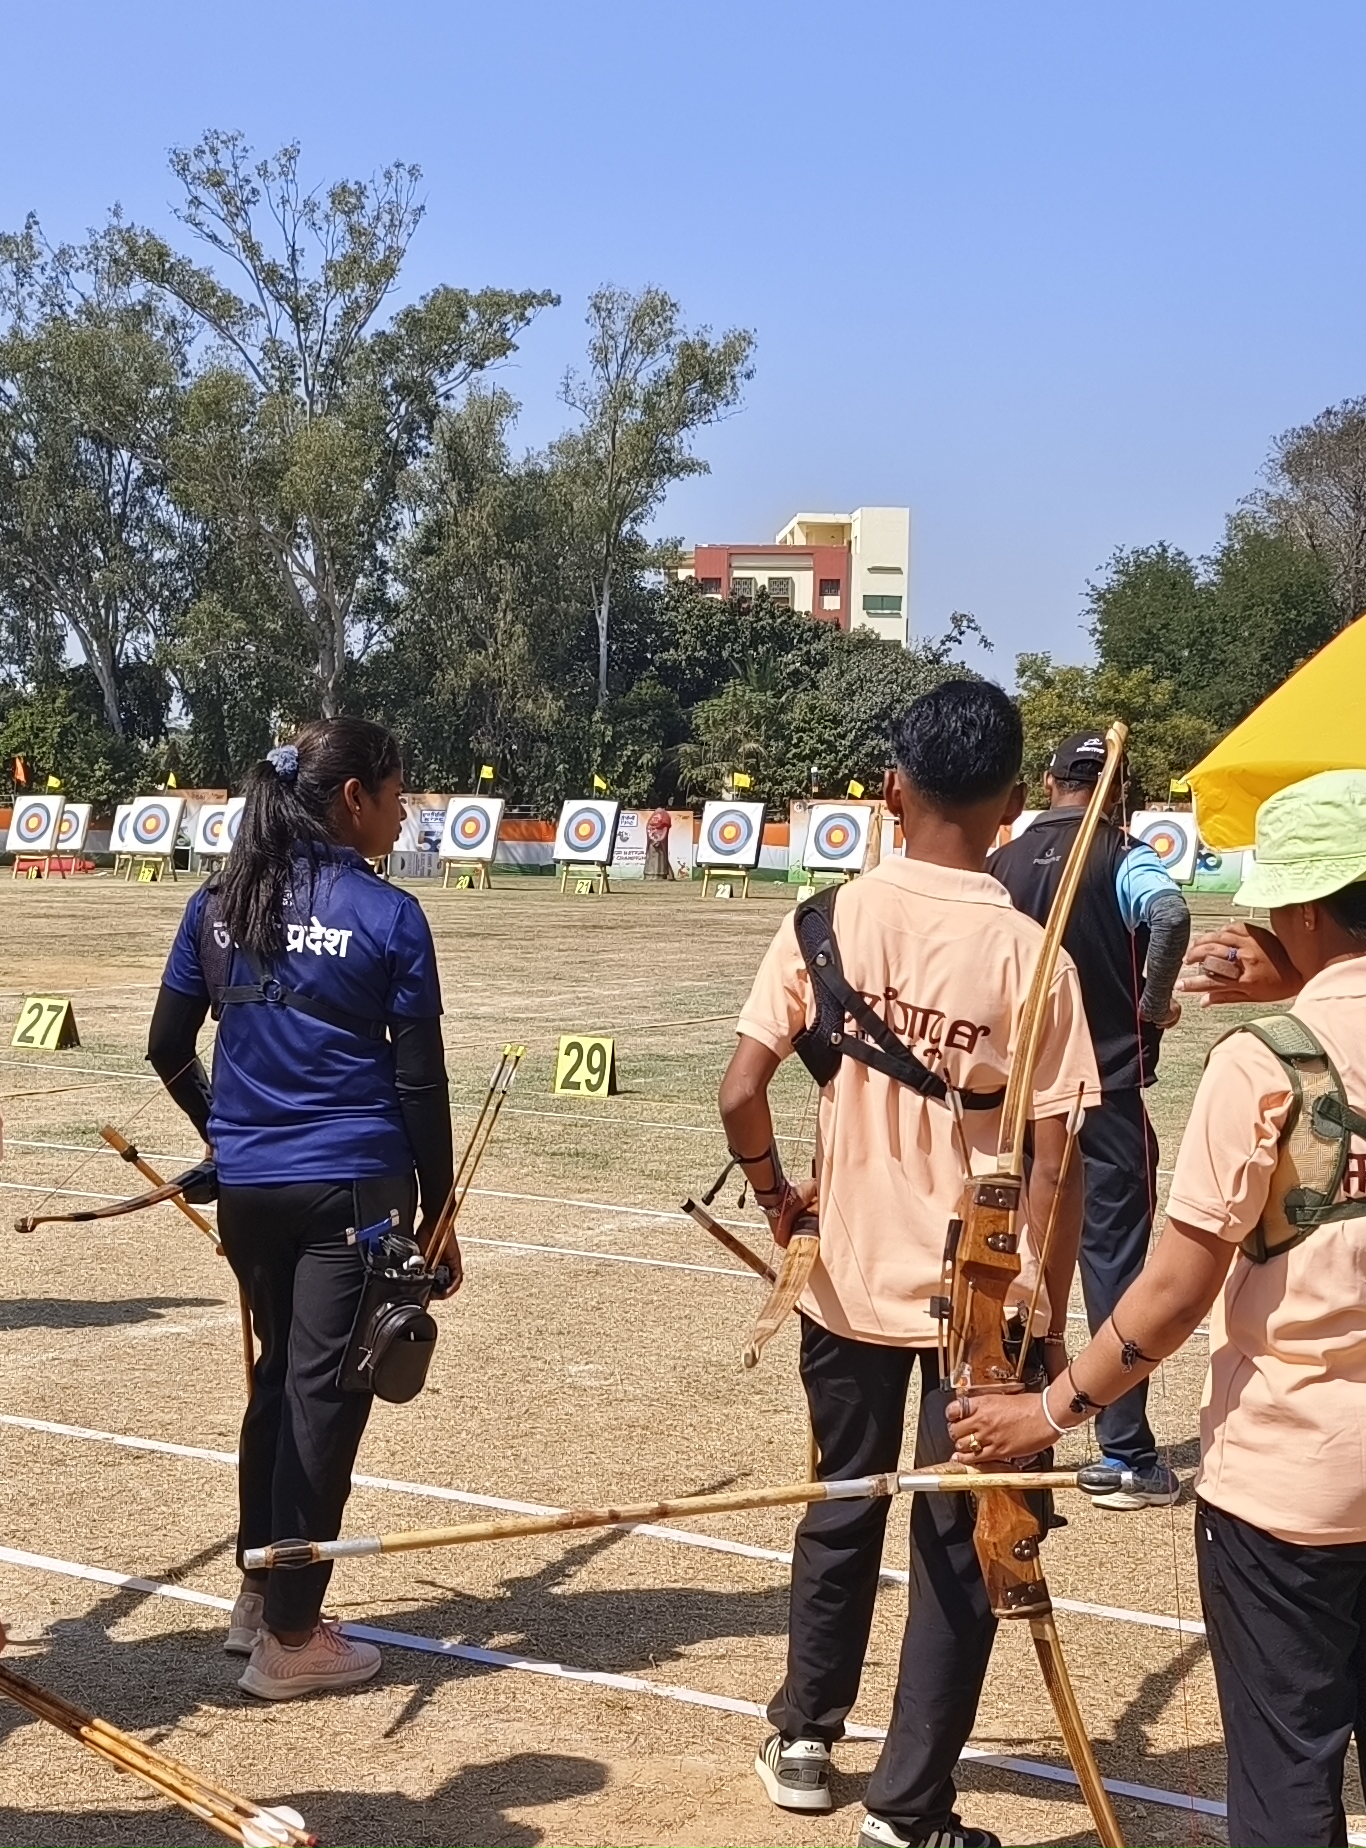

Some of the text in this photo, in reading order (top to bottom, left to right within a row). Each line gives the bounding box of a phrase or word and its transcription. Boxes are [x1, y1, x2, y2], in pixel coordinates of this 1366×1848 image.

[456, 875, 470, 889] 20
[286, 916, 353, 958] प्रदेश
[16, 1002, 63, 1046] 27
[559, 1042, 607, 1092] 29
